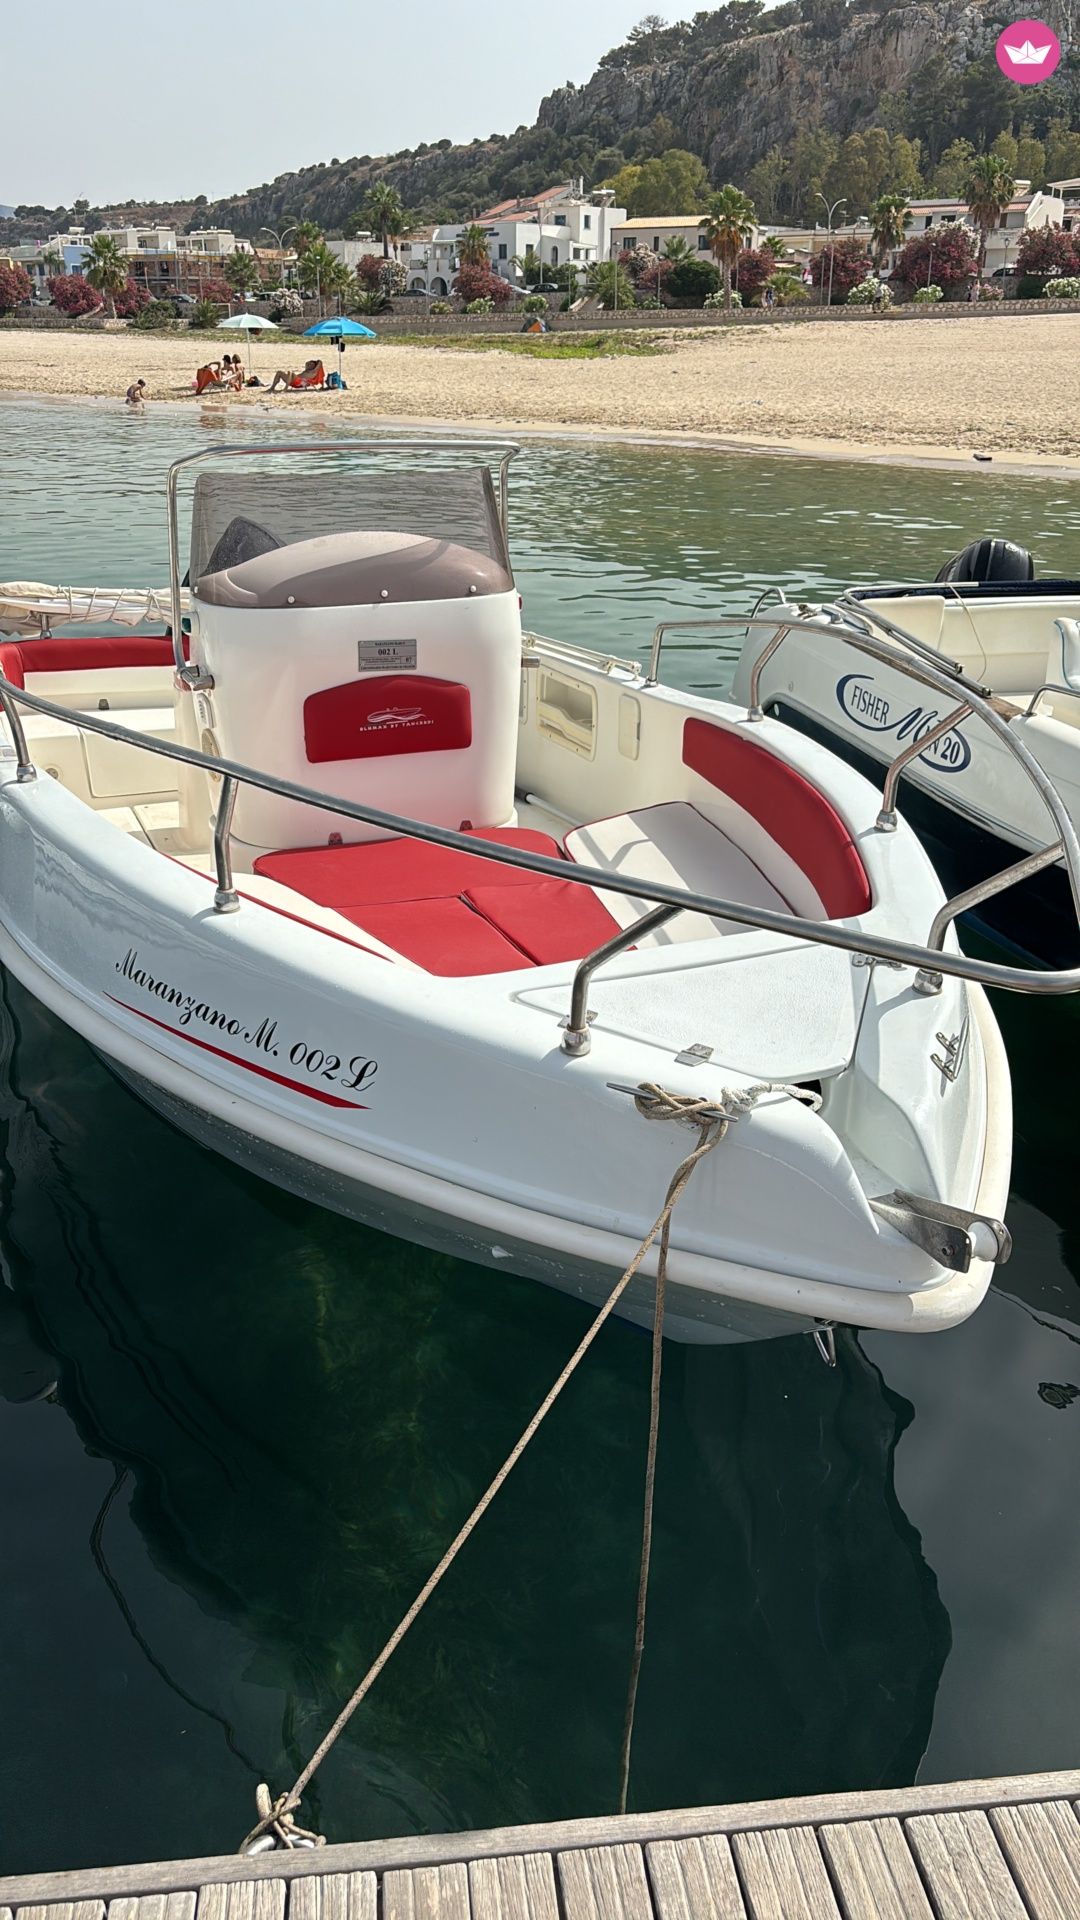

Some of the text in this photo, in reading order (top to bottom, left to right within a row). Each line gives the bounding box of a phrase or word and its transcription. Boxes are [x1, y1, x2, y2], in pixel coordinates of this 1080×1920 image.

[378, 648, 391, 656] 002
[850, 685, 890, 726] FISHER
[940, 737, 961, 764] 20
[115, 948, 248, 1035] Maranzano
